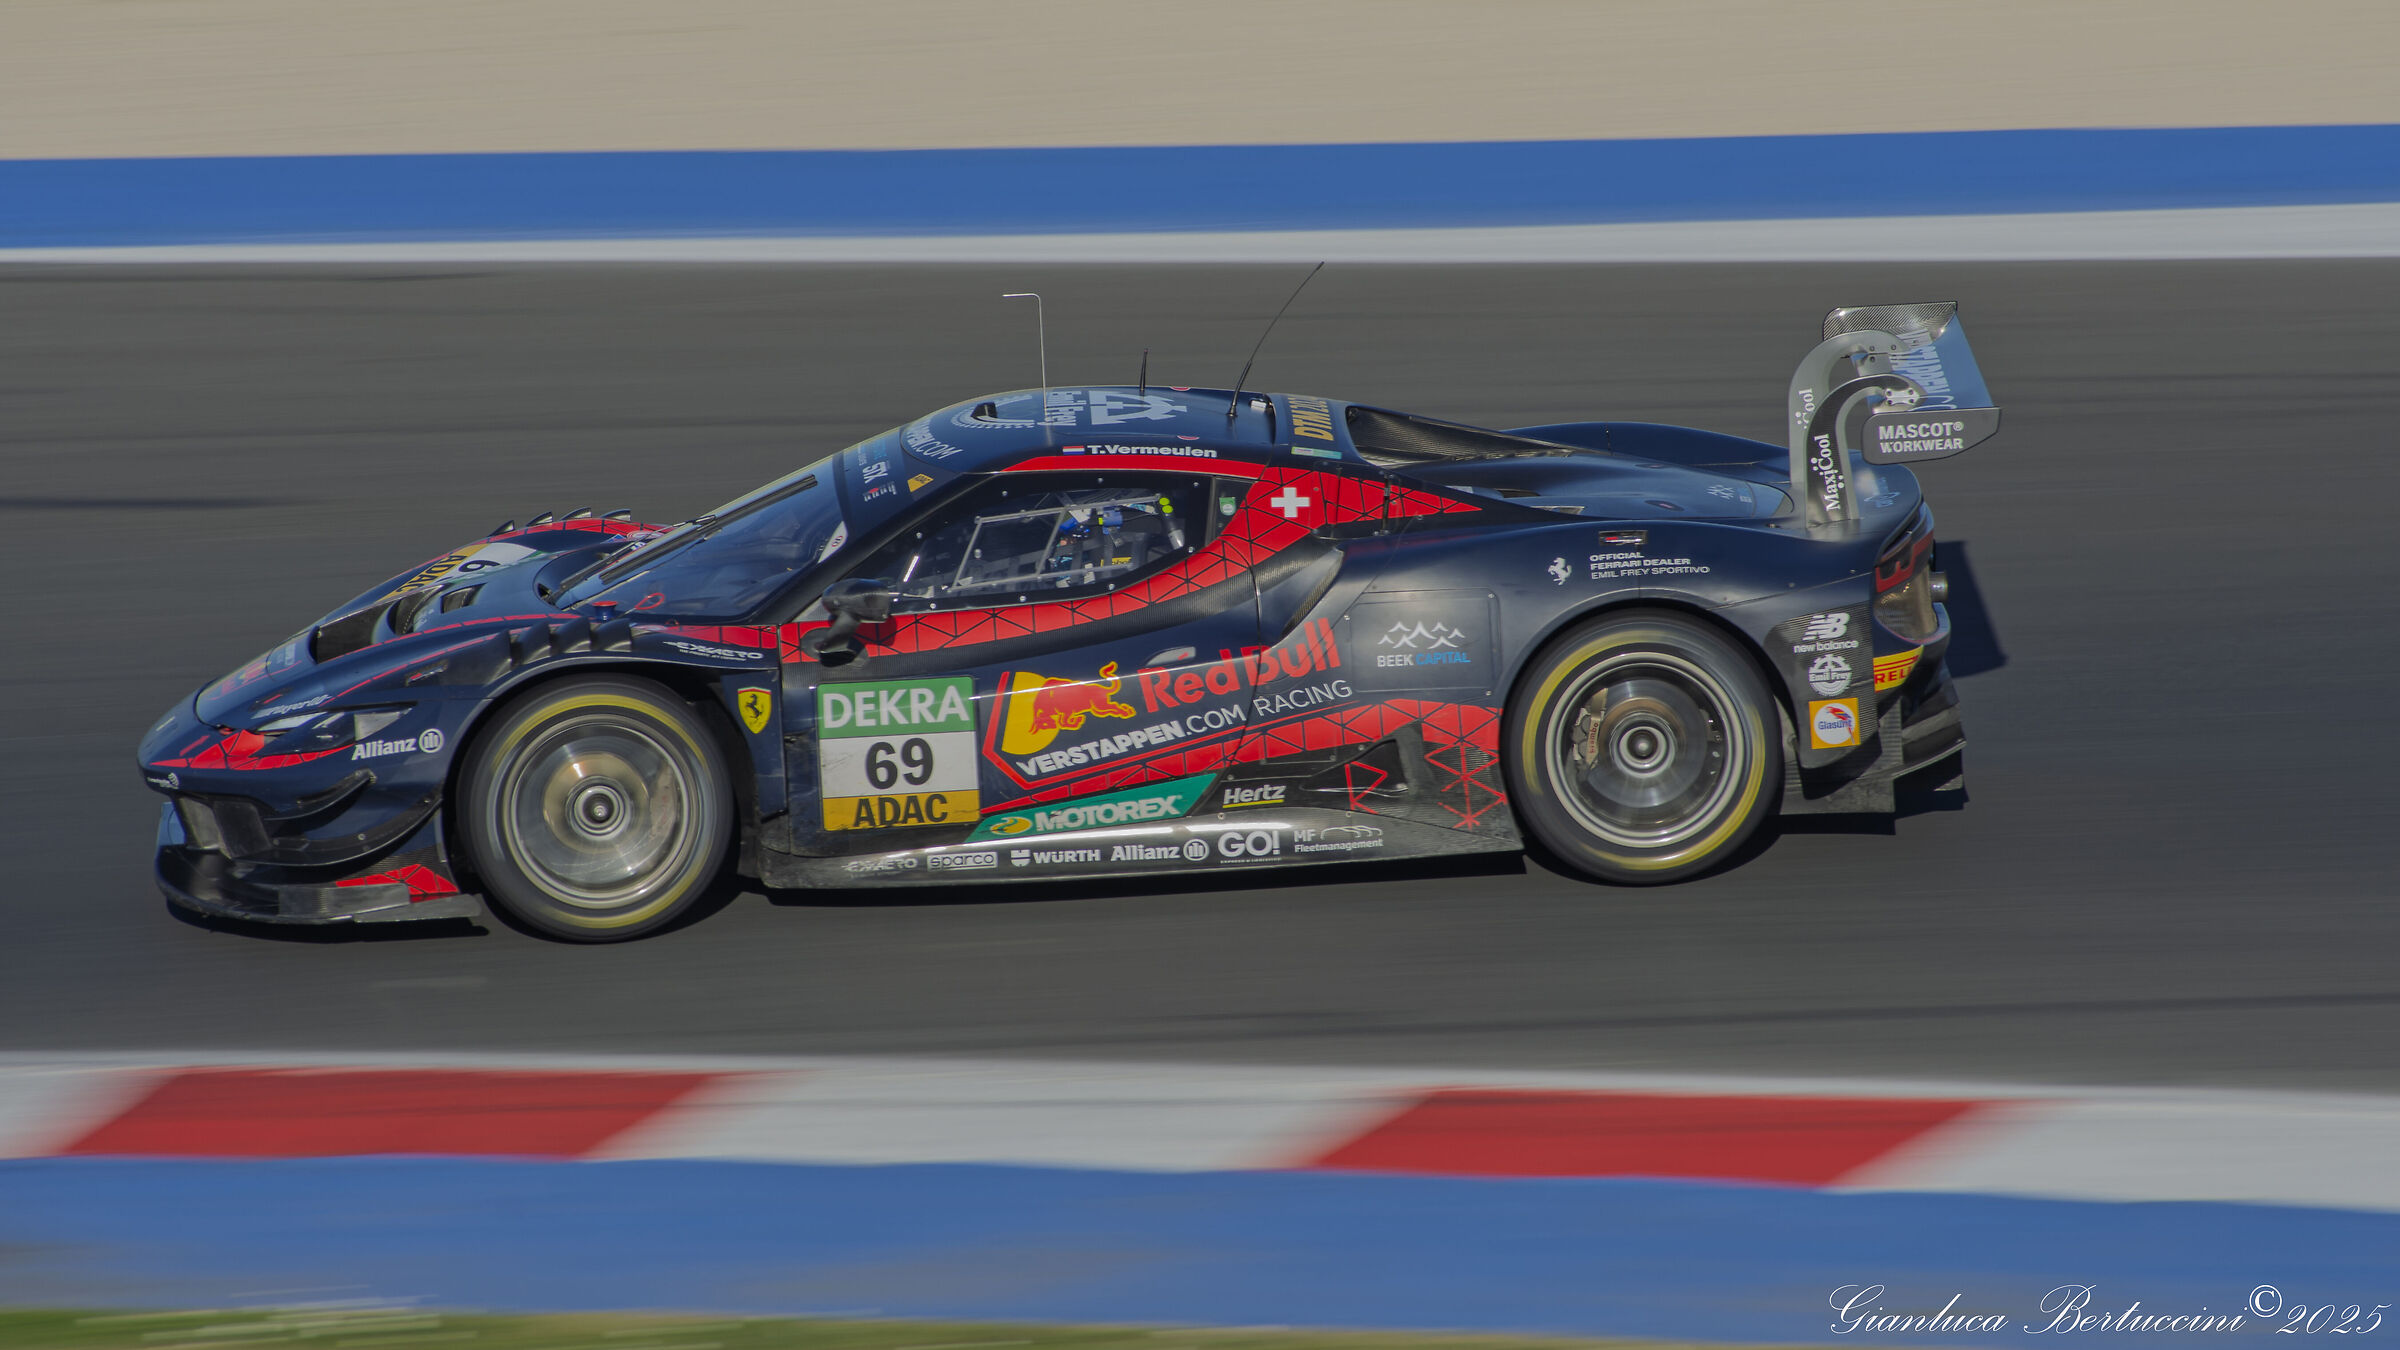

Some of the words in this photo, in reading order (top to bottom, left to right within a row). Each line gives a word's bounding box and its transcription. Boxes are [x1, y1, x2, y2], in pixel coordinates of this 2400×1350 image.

[1291, 410, 1334, 441] DTM
[1880, 438, 1963, 453] WORKWEAR
[1813, 433, 1842, 512] MaxiCool
[1589, 552, 1645, 562] OFFICIAL
[1590, 560, 1641, 570] FERRARI
[1643, 558, 1691, 567] DEALER
[1591, 570, 1619, 580] EMIL
[1620, 568, 1650, 577] FREY
[1651, 566, 1711, 575] SPORTIVO
[1793, 644, 1816, 654] new
[1816, 640, 1859, 651] balance
[1138, 648, 1240, 713] Red
[1241, 618, 1341, 686] Bull
[1377, 654, 1414, 668] BEEK
[1416, 651, 1471, 666] CAPITAL
[1809, 673, 1830, 682] Emil
[1831, 671, 1852, 682] Frey
[822, 685, 970, 729] DEKRA
[1016, 704, 1247, 777] VERSTAPPEN.COM
[1253, 680, 1353, 717] RACING
[352, 737, 417, 760] Allianz
[866, 738, 934, 789] 69
[1223, 785, 1286, 805] Hertz
[854, 793, 948, 828] ADAC
[1035, 796, 1180, 832] MOTOREX
[1218, 831, 1280, 857] GO!
[1294, 829, 1317, 843] MF
[1110, 845, 1181, 862] Allianz
[1294, 838, 1384, 853] Fleetmanagement
[930, 852, 995, 866] sparco
